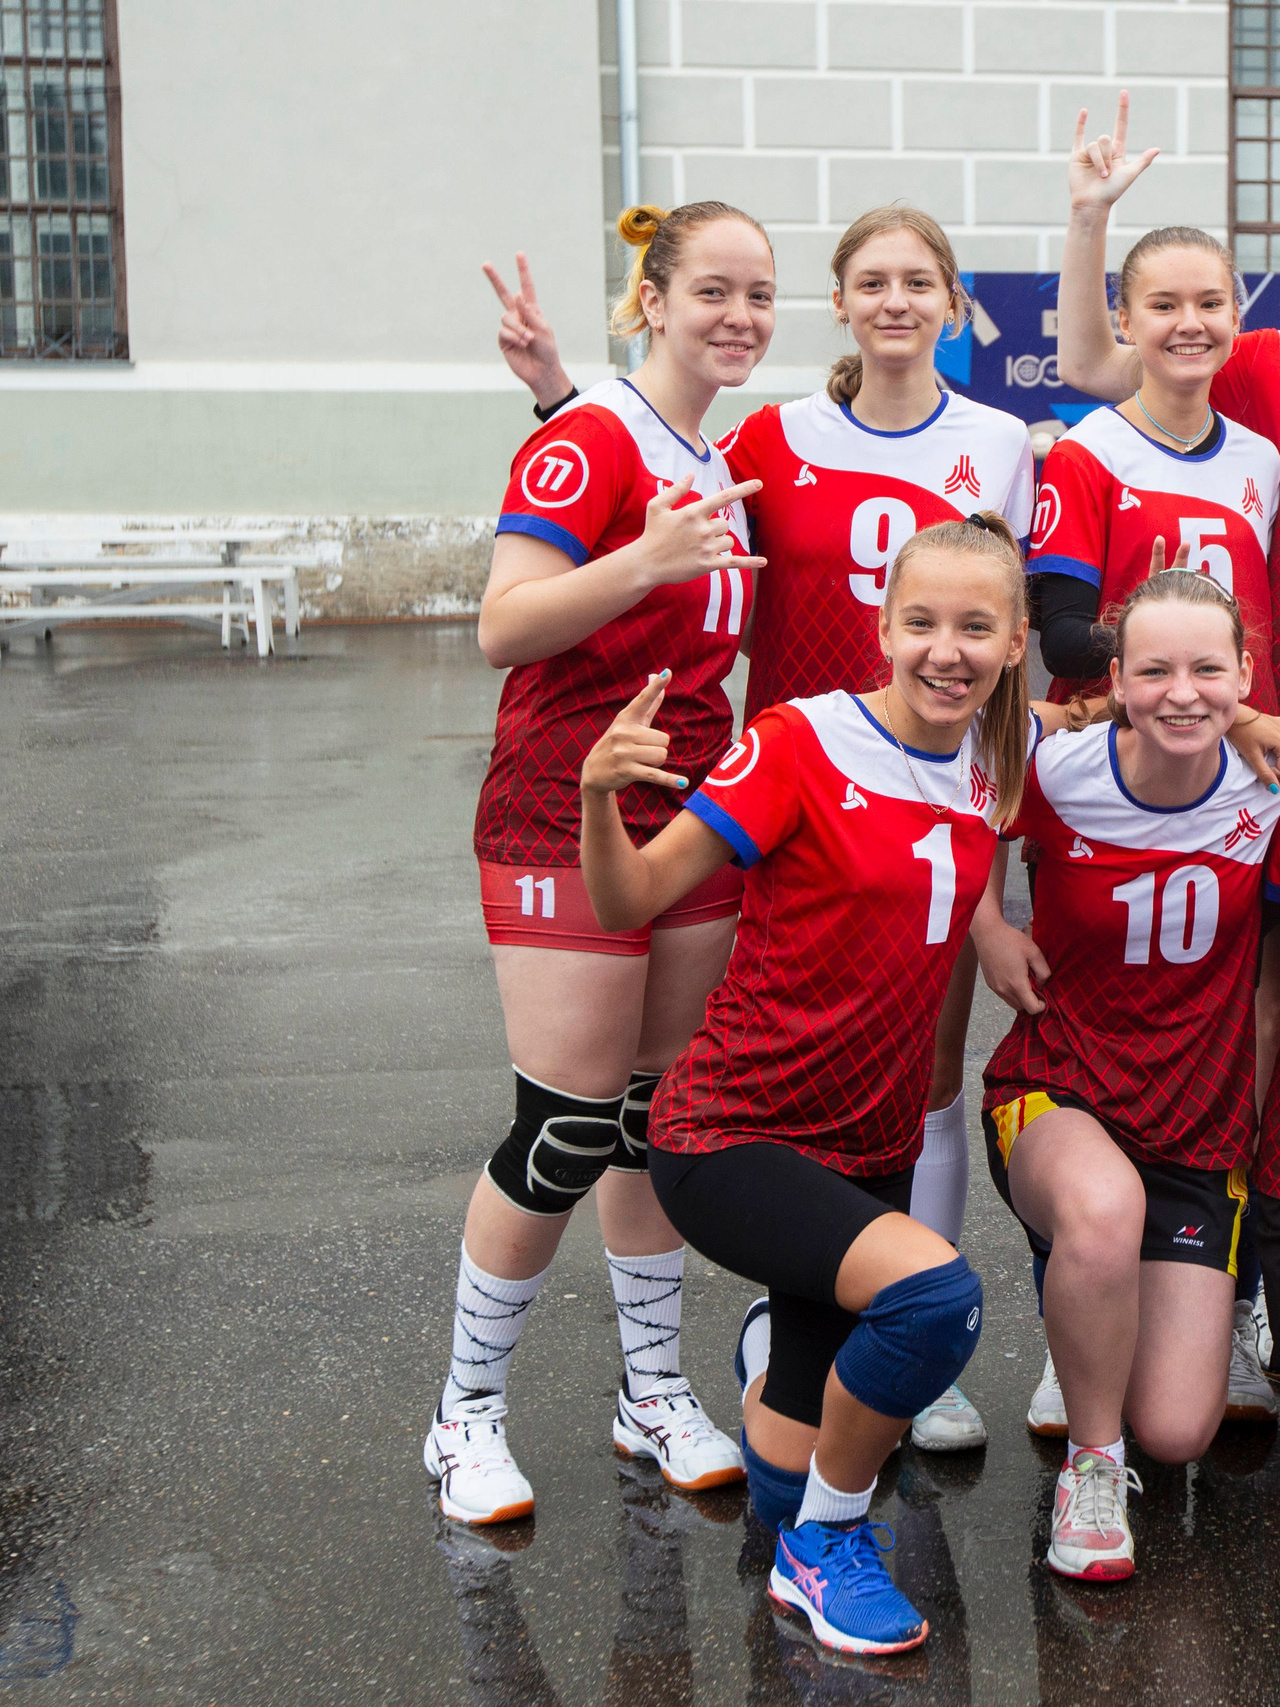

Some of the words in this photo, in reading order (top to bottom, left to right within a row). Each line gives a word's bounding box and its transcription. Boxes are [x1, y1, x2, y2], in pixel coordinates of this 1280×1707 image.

[536, 455, 574, 492] 77
[848, 496, 917, 607] 9
[1178, 517, 1234, 602] 5
[514, 874, 555, 919] 11
[911, 823, 957, 945] 1
[1112, 864, 1220, 965] 10
[1172, 1236, 1205, 1248] WINRISE
